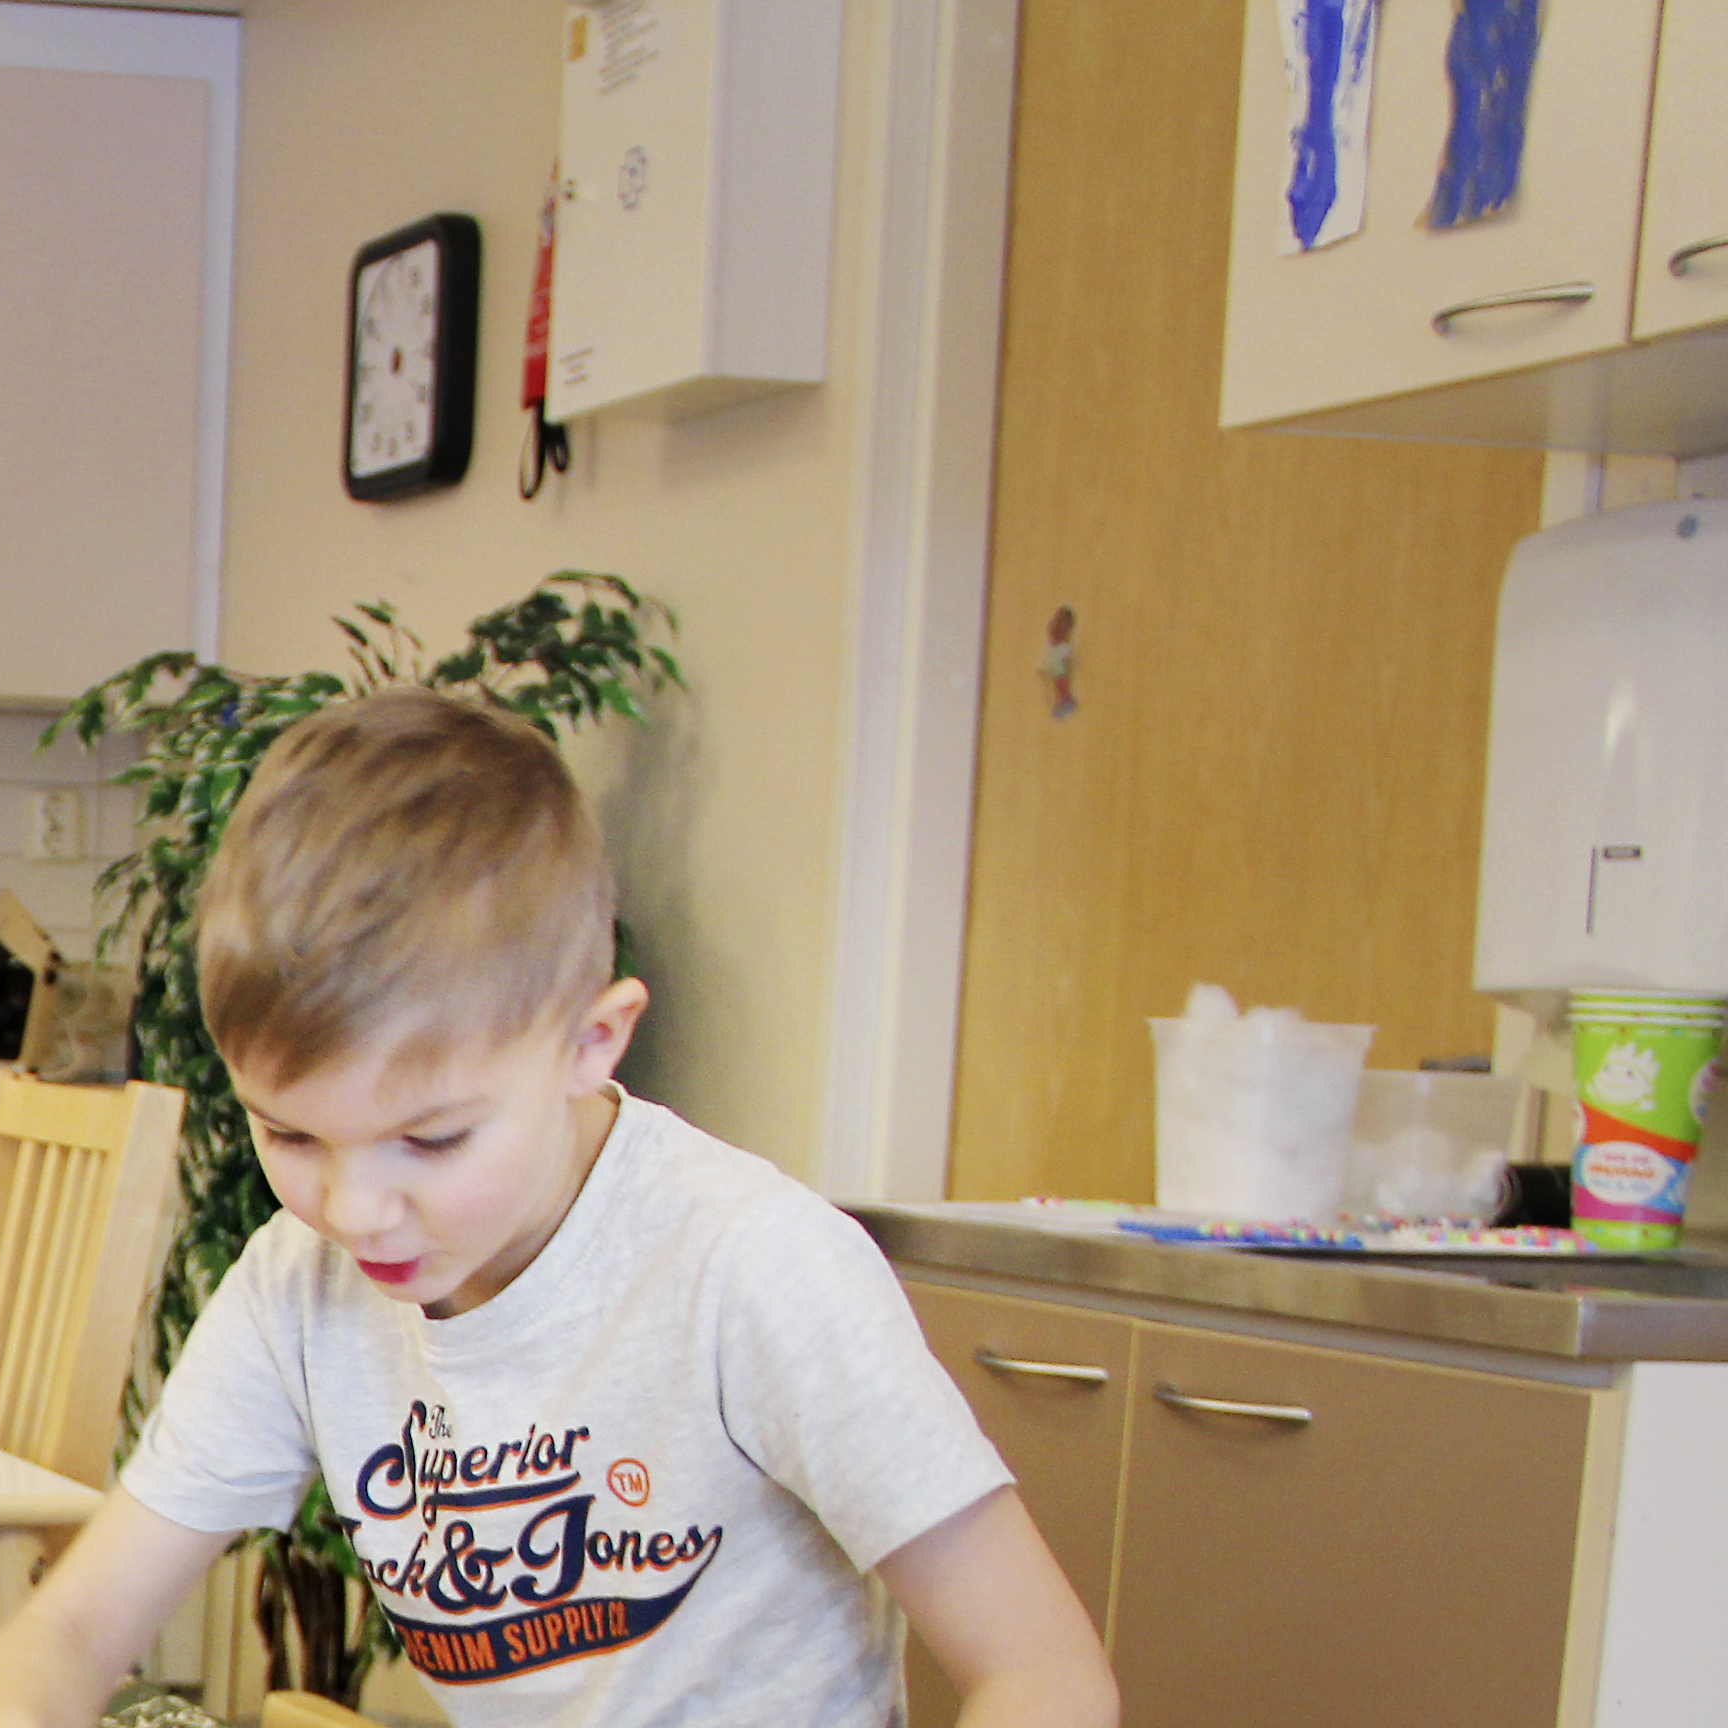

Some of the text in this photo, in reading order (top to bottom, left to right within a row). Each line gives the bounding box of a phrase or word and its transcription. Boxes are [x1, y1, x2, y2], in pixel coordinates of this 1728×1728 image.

[355, 1399, 591, 1527] Superior
[613, 1471, 645, 1494] TM
[501, 1601, 606, 1664] SUPPLY
